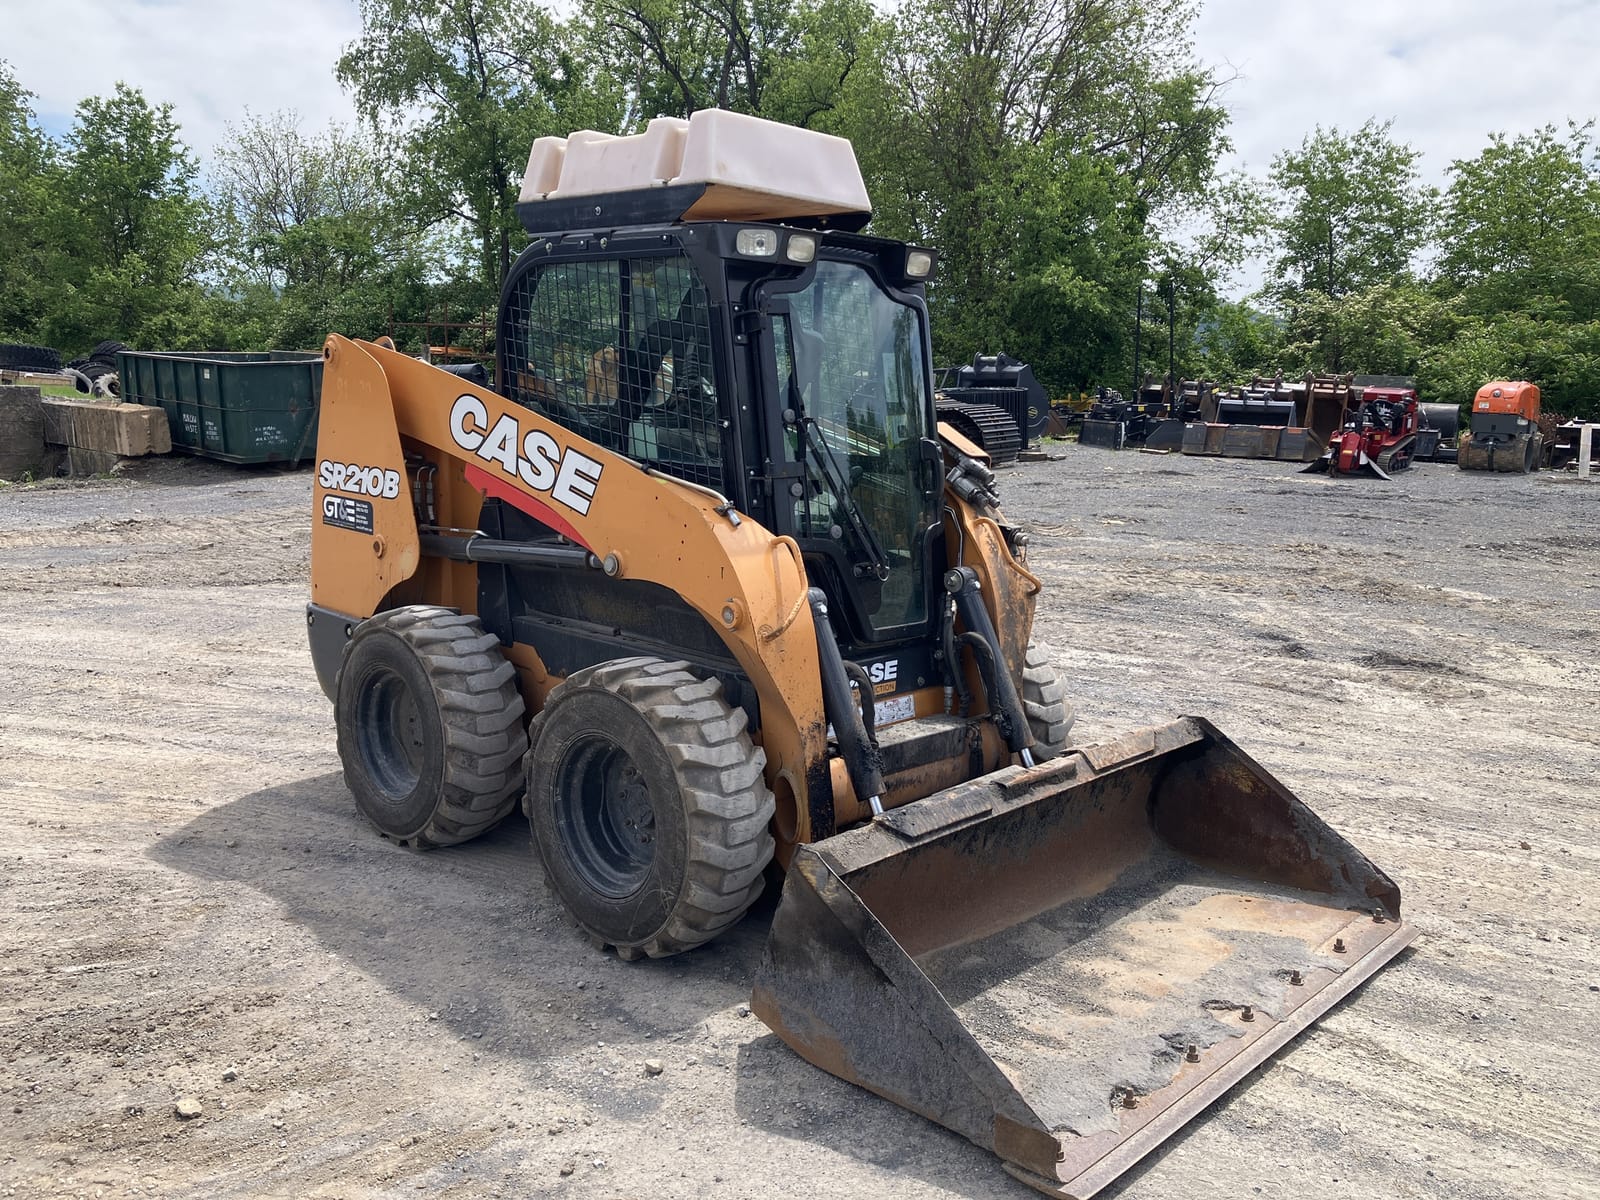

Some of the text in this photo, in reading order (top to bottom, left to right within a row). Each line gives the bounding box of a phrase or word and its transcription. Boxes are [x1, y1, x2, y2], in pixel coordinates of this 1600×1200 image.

[449, 393, 605, 517] CASE
[319, 459, 400, 499] SR210B
[849, 659, 898, 688] ASE
